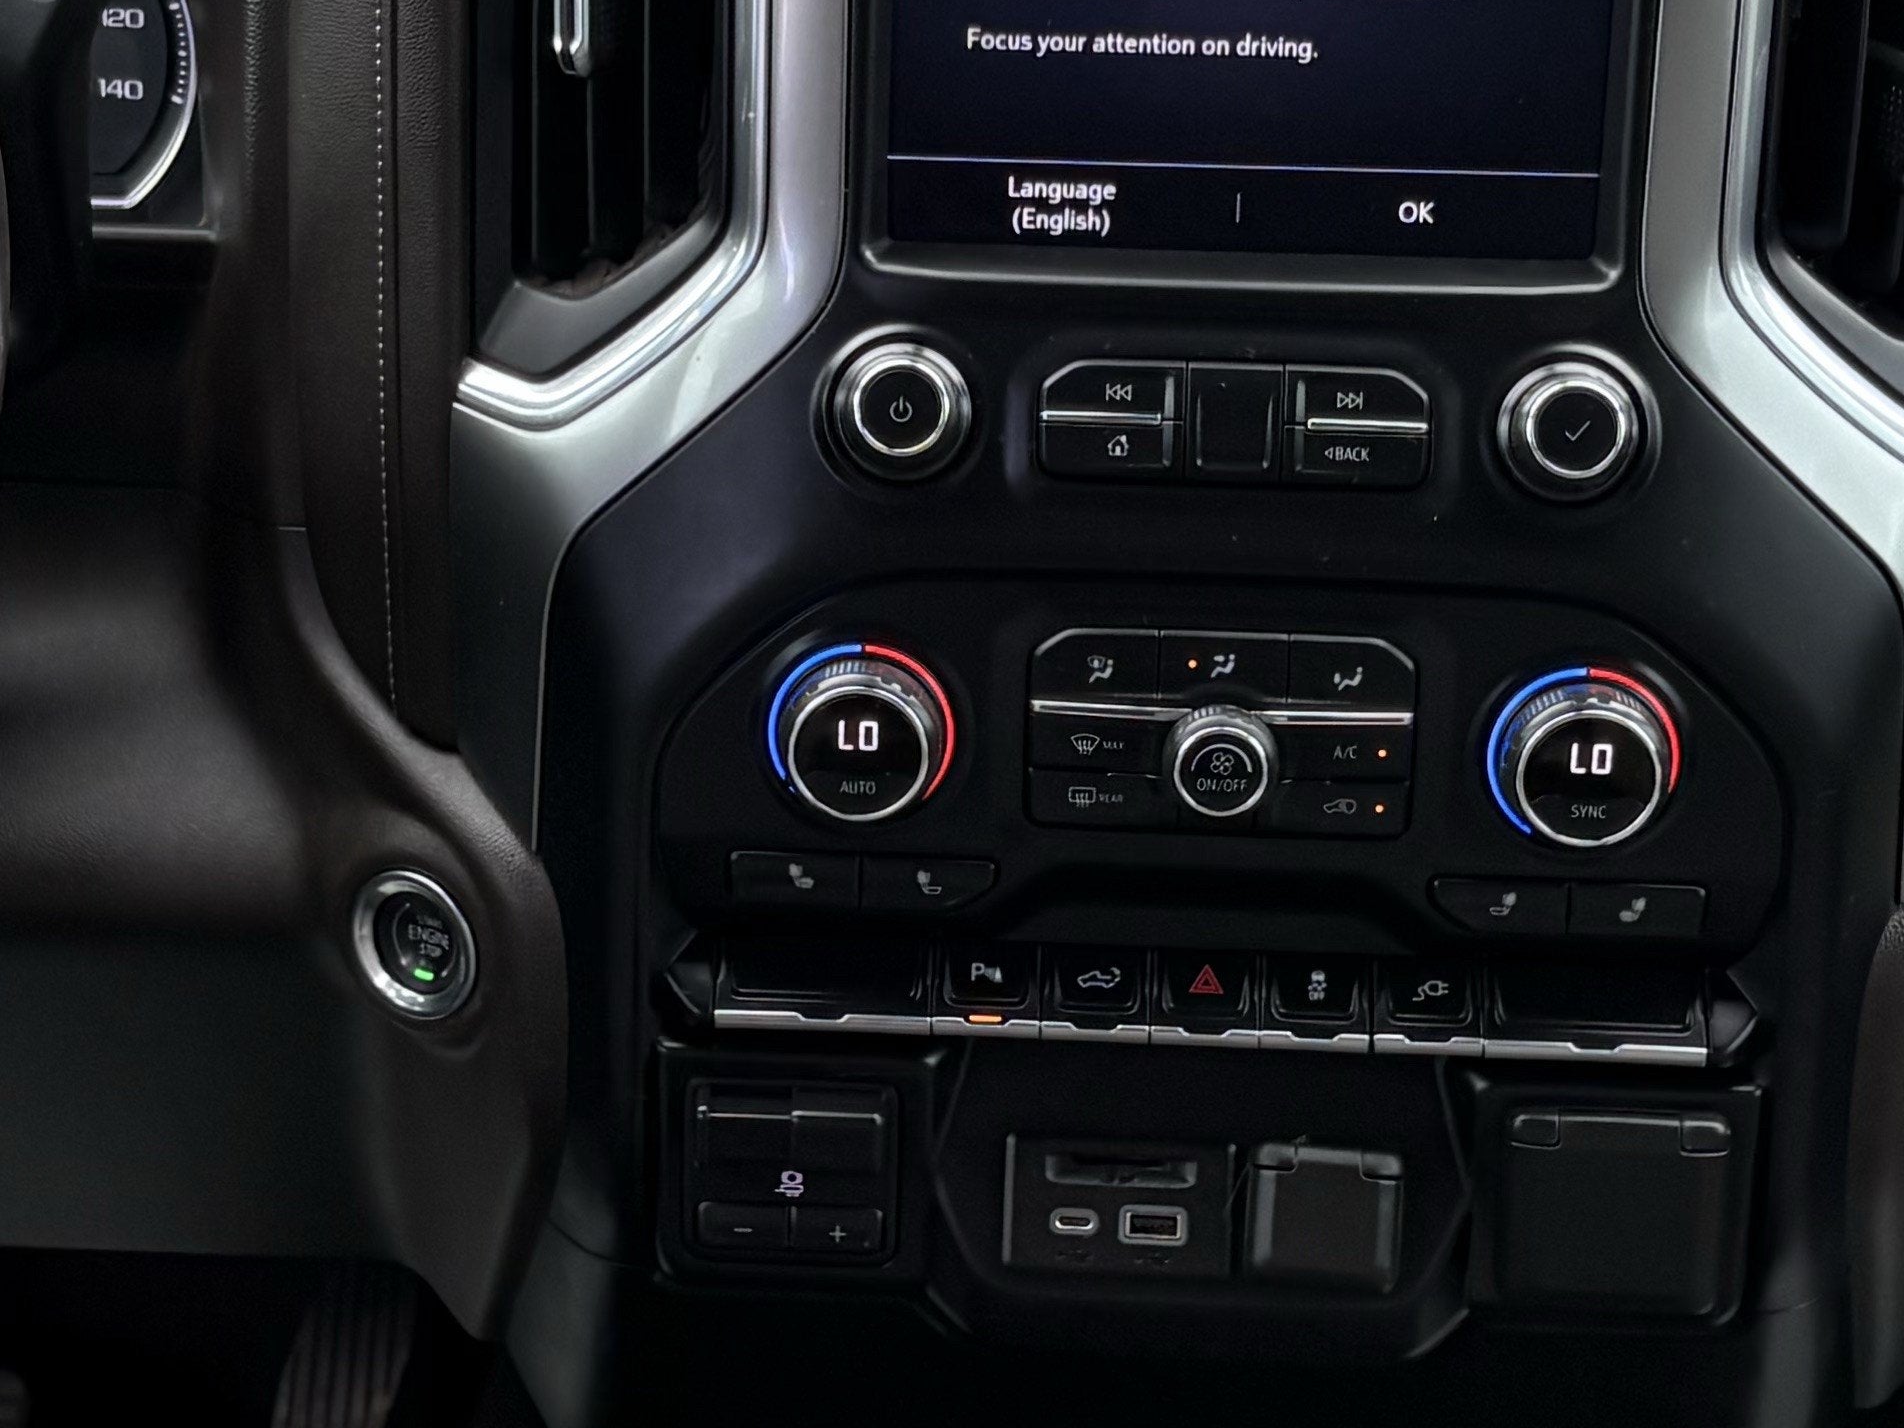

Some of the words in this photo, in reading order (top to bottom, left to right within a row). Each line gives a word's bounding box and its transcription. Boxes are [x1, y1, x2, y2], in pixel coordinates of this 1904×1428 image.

[101, 7, 145, 29] 120
[967, 26, 1033, 51] Focus
[1037, 33, 1087, 57] your
[1092, 32, 1196, 56] attention
[1201, 38, 1231, 57] on
[1236, 32, 1319, 64] driving.
[97, 77, 144, 101] 140
[1007, 175, 1117, 205] Language
[1012, 206, 1111, 237] (English)
[1398, 201, 1435, 225] OK
[1335, 446, 1370, 462] BACK
[837, 719, 879, 752] LO
[1332, 744, 1358, 760] A/C
[1569, 742, 1614, 776] LO
[839, 780, 877, 795] AUTO
[1196, 778, 1248, 793] ON/OFF
[1570, 804, 1607, 820] SYNC
